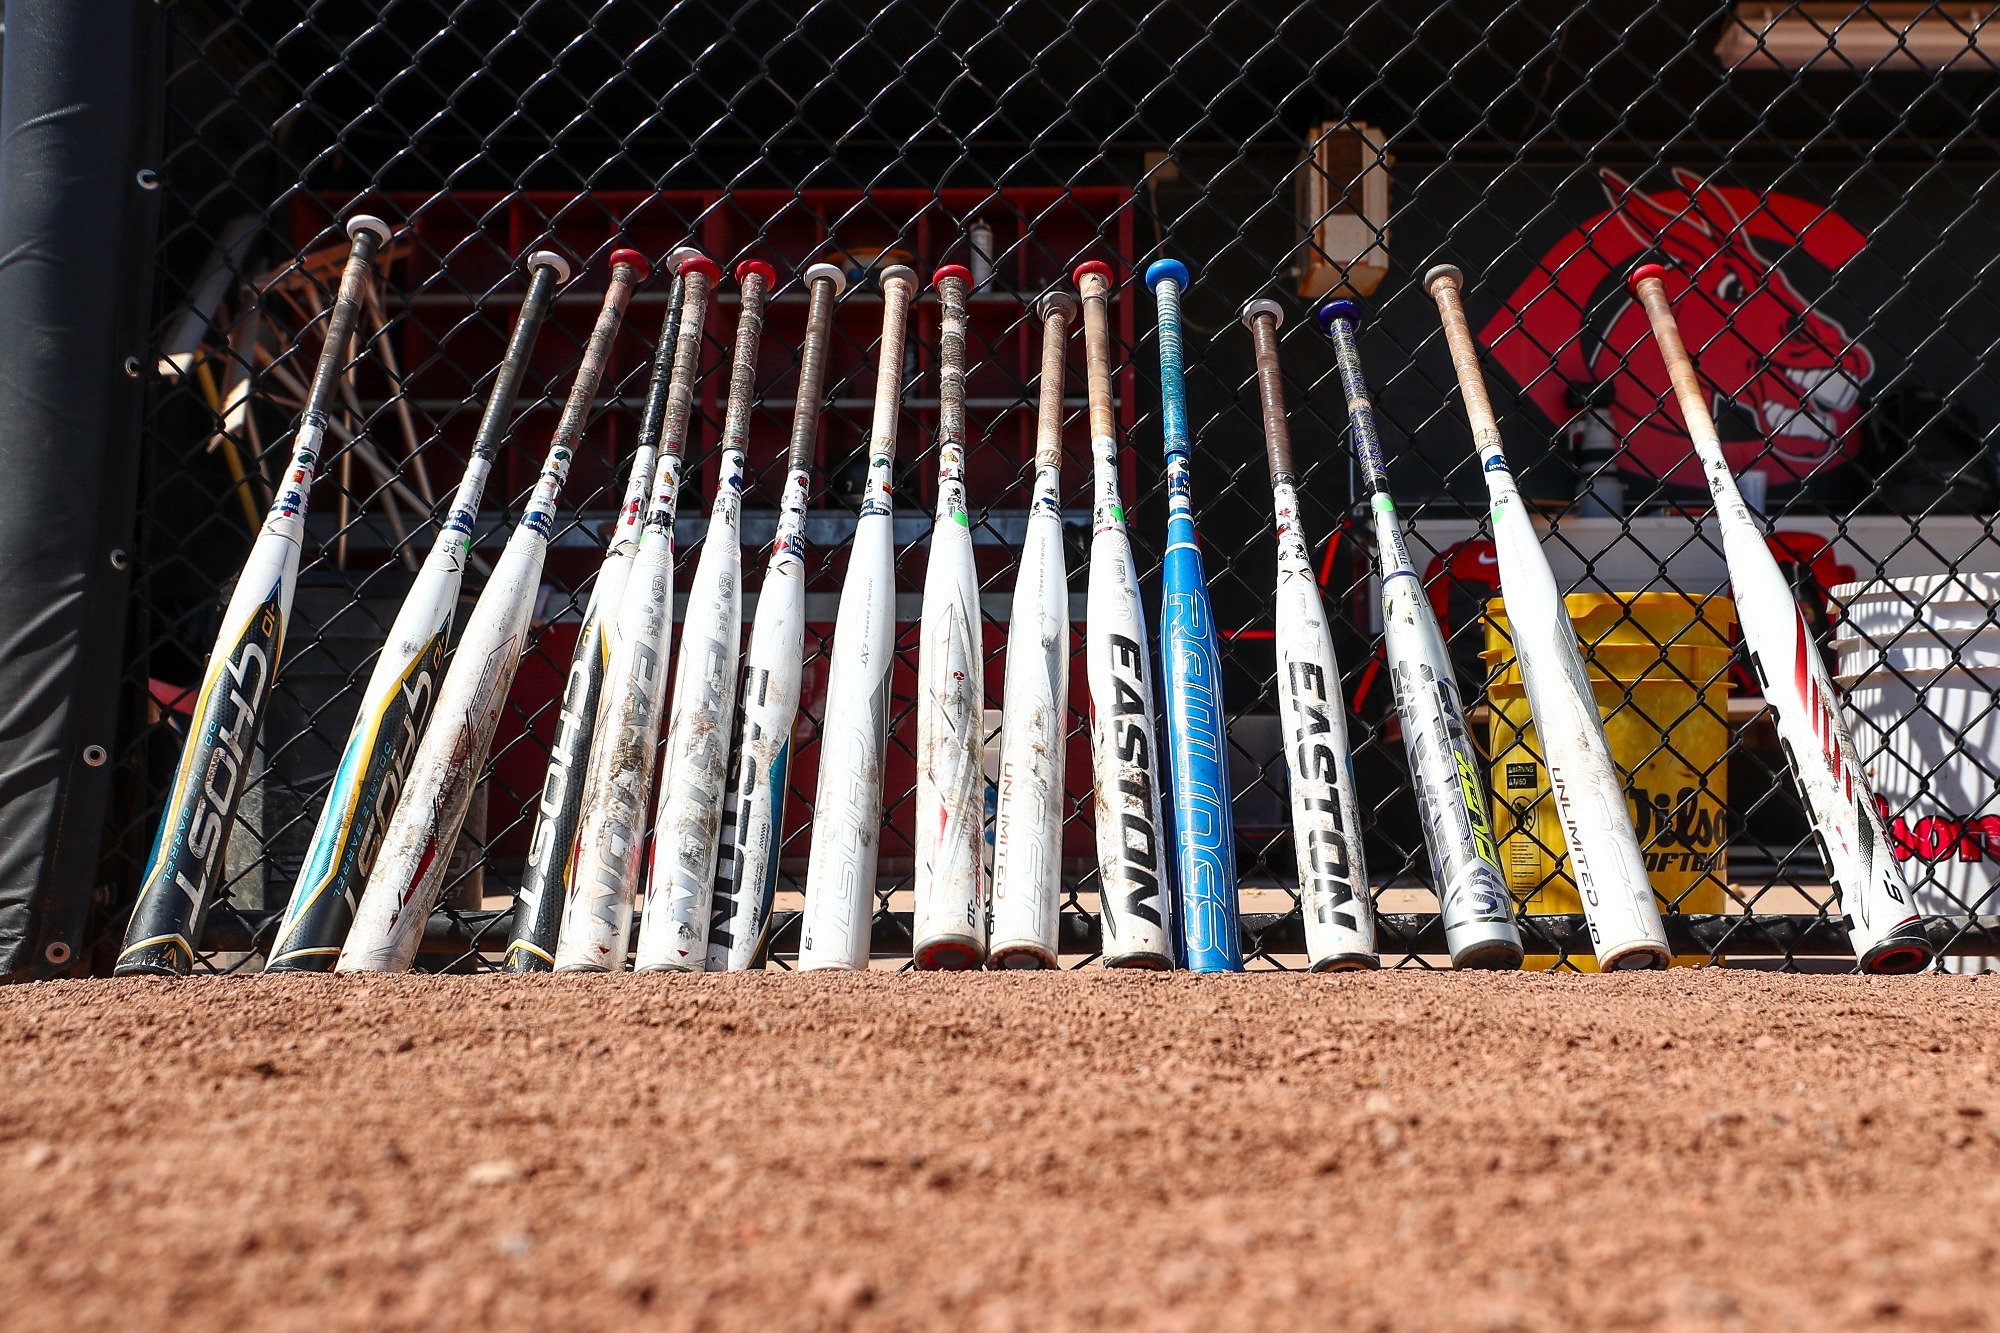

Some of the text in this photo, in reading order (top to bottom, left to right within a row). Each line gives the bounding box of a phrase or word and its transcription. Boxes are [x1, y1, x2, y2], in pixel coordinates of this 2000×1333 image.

[1391, 529, 1409, 566] LOUISVILLE
[161, 806, 192, 884] BARREL
[175, 642, 268, 936] GHOST
[995, 762, 1014, 900] UNLIMITED
[1106, 633, 1162, 930] EASTON
[1168, 589, 1230, 961] RAWLINGS
[1288, 661, 1357, 932] EASTON
[1552, 766, 1599, 907] UNLIMITED
[332, 821, 363, 898] BARREL
